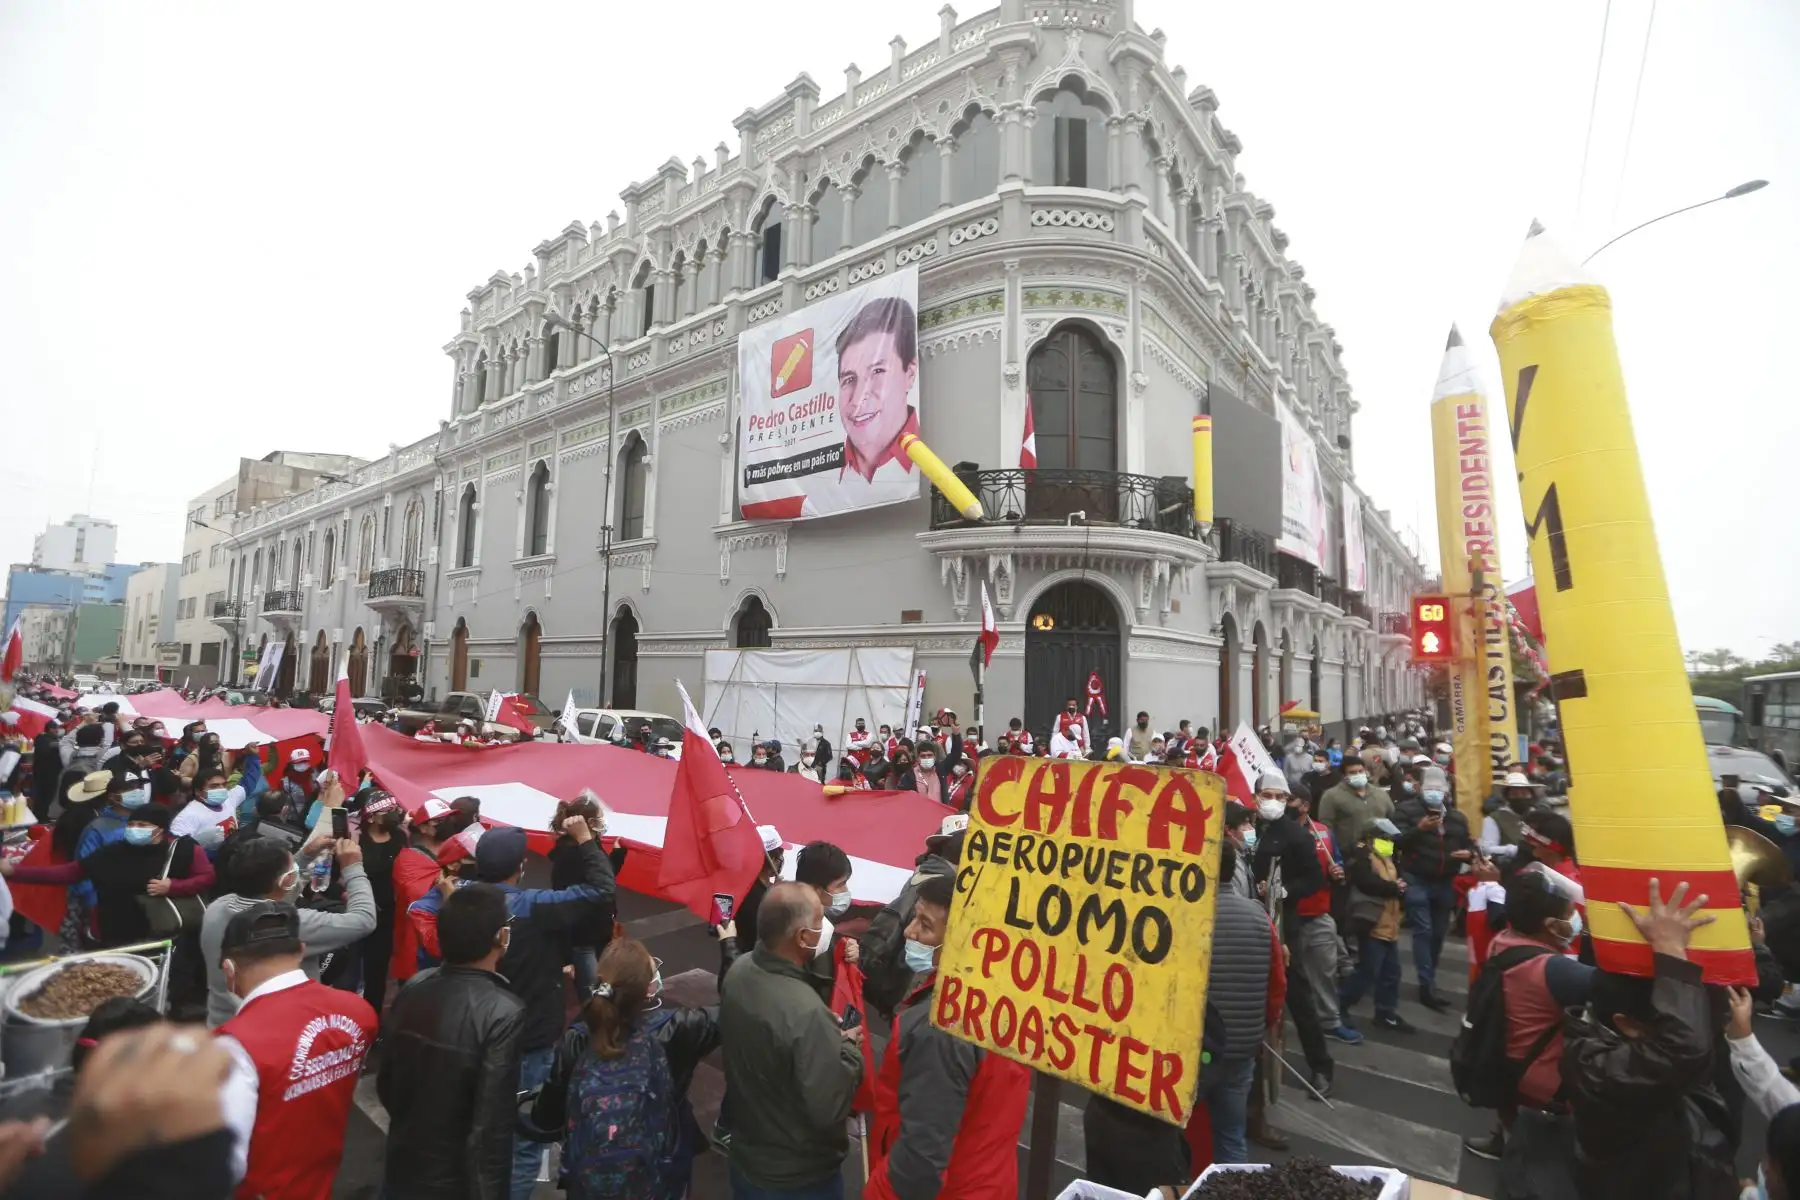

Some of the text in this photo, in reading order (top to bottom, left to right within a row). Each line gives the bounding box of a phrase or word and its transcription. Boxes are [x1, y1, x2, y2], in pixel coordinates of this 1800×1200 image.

[749, 392, 835, 432] Pedro Castillo
[749, 412, 835, 443] PRESIDENTE
[752, 465, 766, 479] más
[767, 460, 793, 479] pobres
[793, 461, 801, 472] en
[801, 458, 811, 469] un
[811, 451, 826, 470] país
[1419, 604, 1444, 622] 60
[1456, 674, 1465, 733] GAMARRA
[977, 757, 1213, 855] CHIFA
[967, 829, 1206, 903] AEROPUERTO
[1004, 876, 1173, 965] LOMO
[971, 927, 1134, 1022] POLLO
[288, 1015, 328, 1080] COORDINADORA
[936, 975, 1184, 1122] BROASTER
